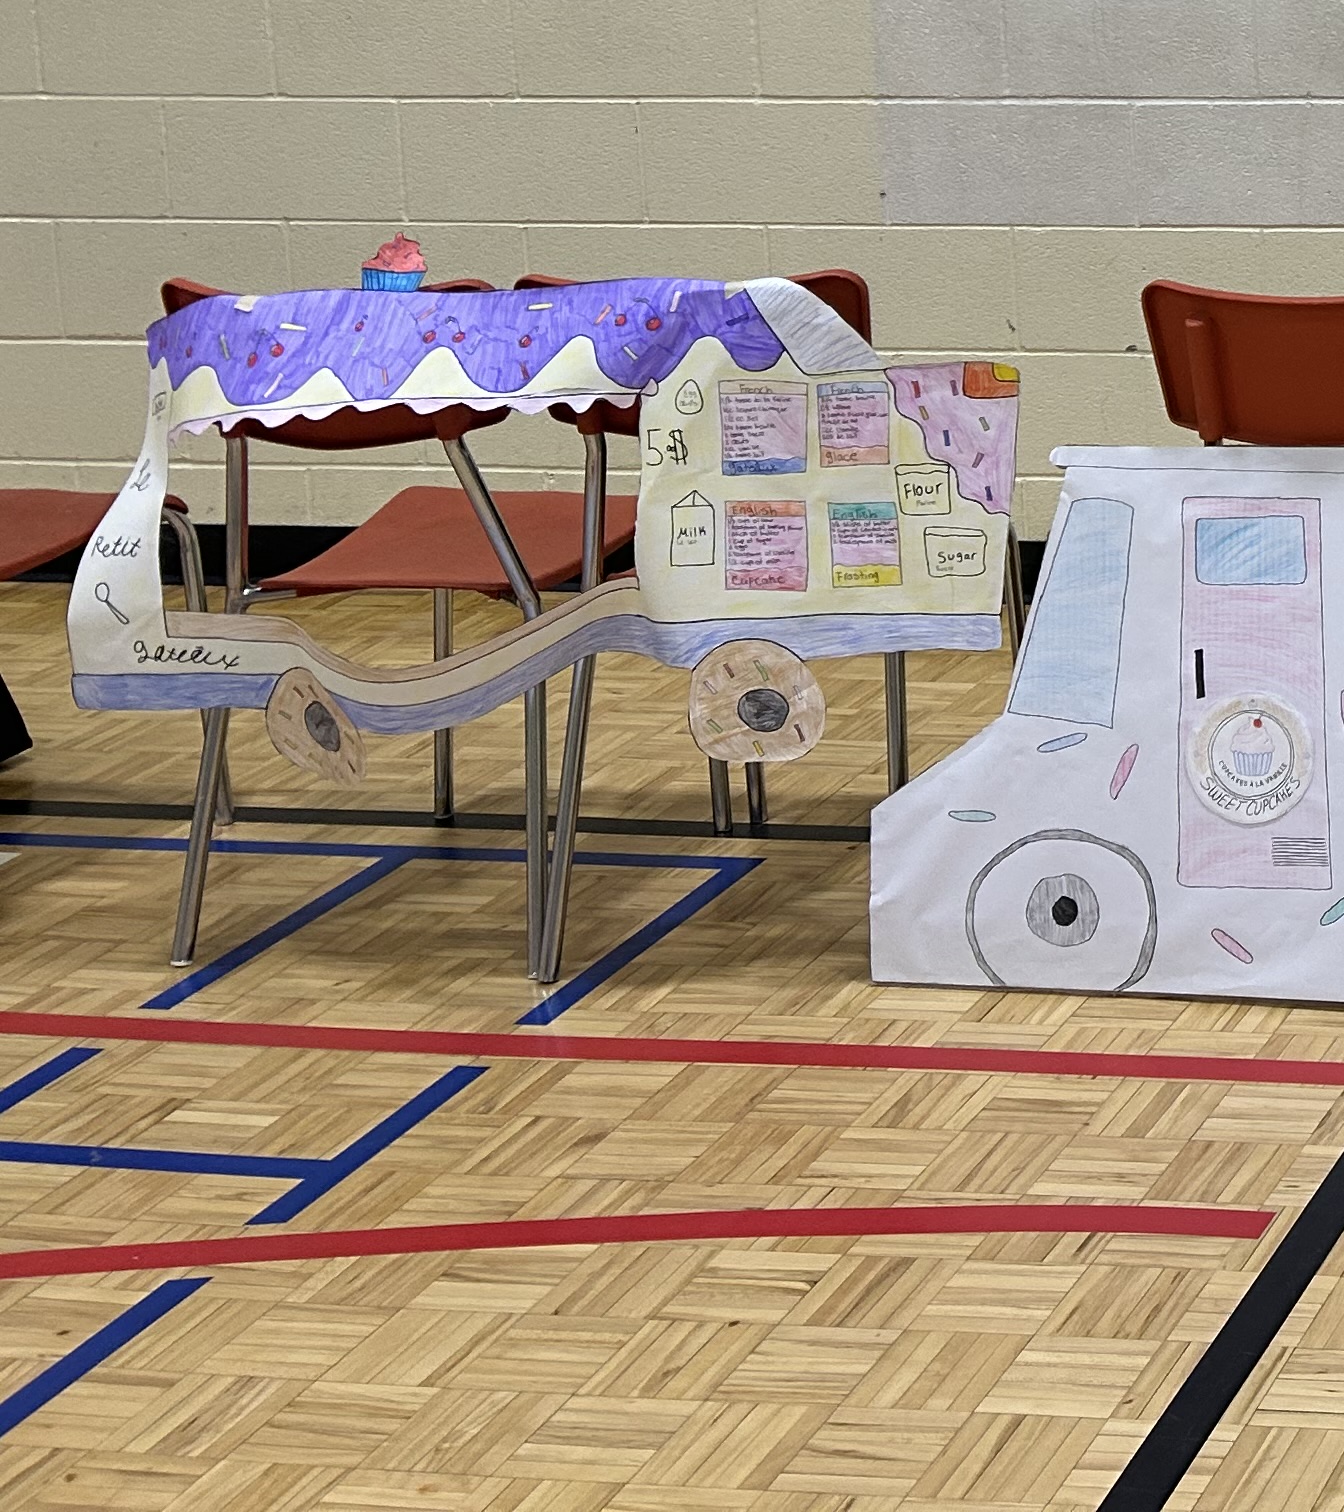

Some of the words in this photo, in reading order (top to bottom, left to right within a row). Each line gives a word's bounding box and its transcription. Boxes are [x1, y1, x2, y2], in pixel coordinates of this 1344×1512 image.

[904, 482, 944, 499] Flour
[677, 526, 707, 539] Milk
[937, 551, 977, 563] Sugar
[1200, 776, 1247, 811] SWEET
